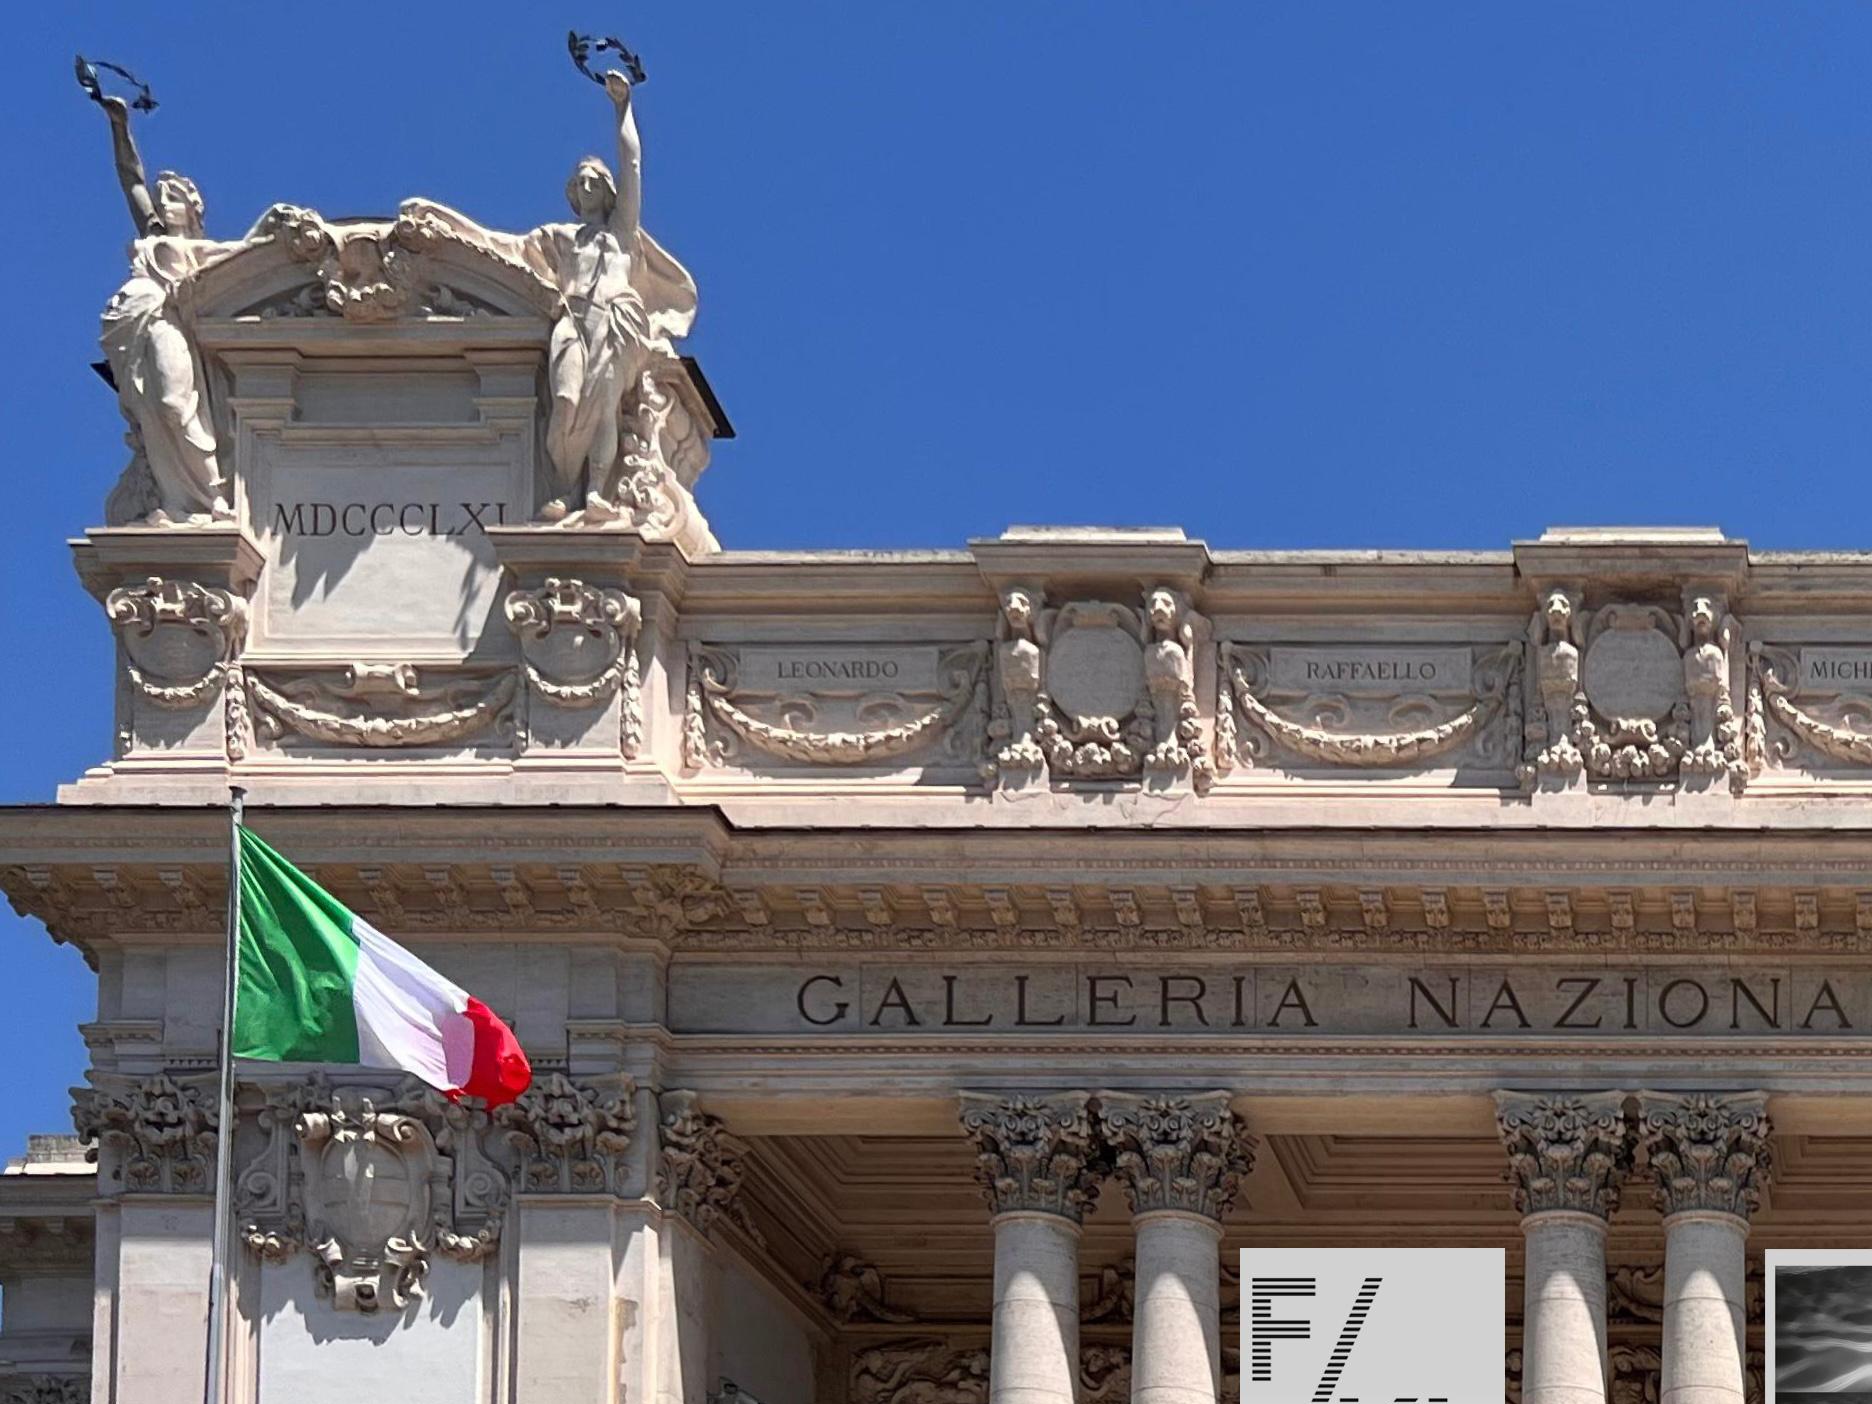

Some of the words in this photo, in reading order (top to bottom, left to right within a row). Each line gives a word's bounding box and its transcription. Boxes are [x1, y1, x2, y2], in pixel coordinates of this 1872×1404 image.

[777, 660, 898, 679] LEONARDO
[1306, 661, 1437, 680] RAFFAELLO
[797, 975, 1318, 1027] GALLERIA
